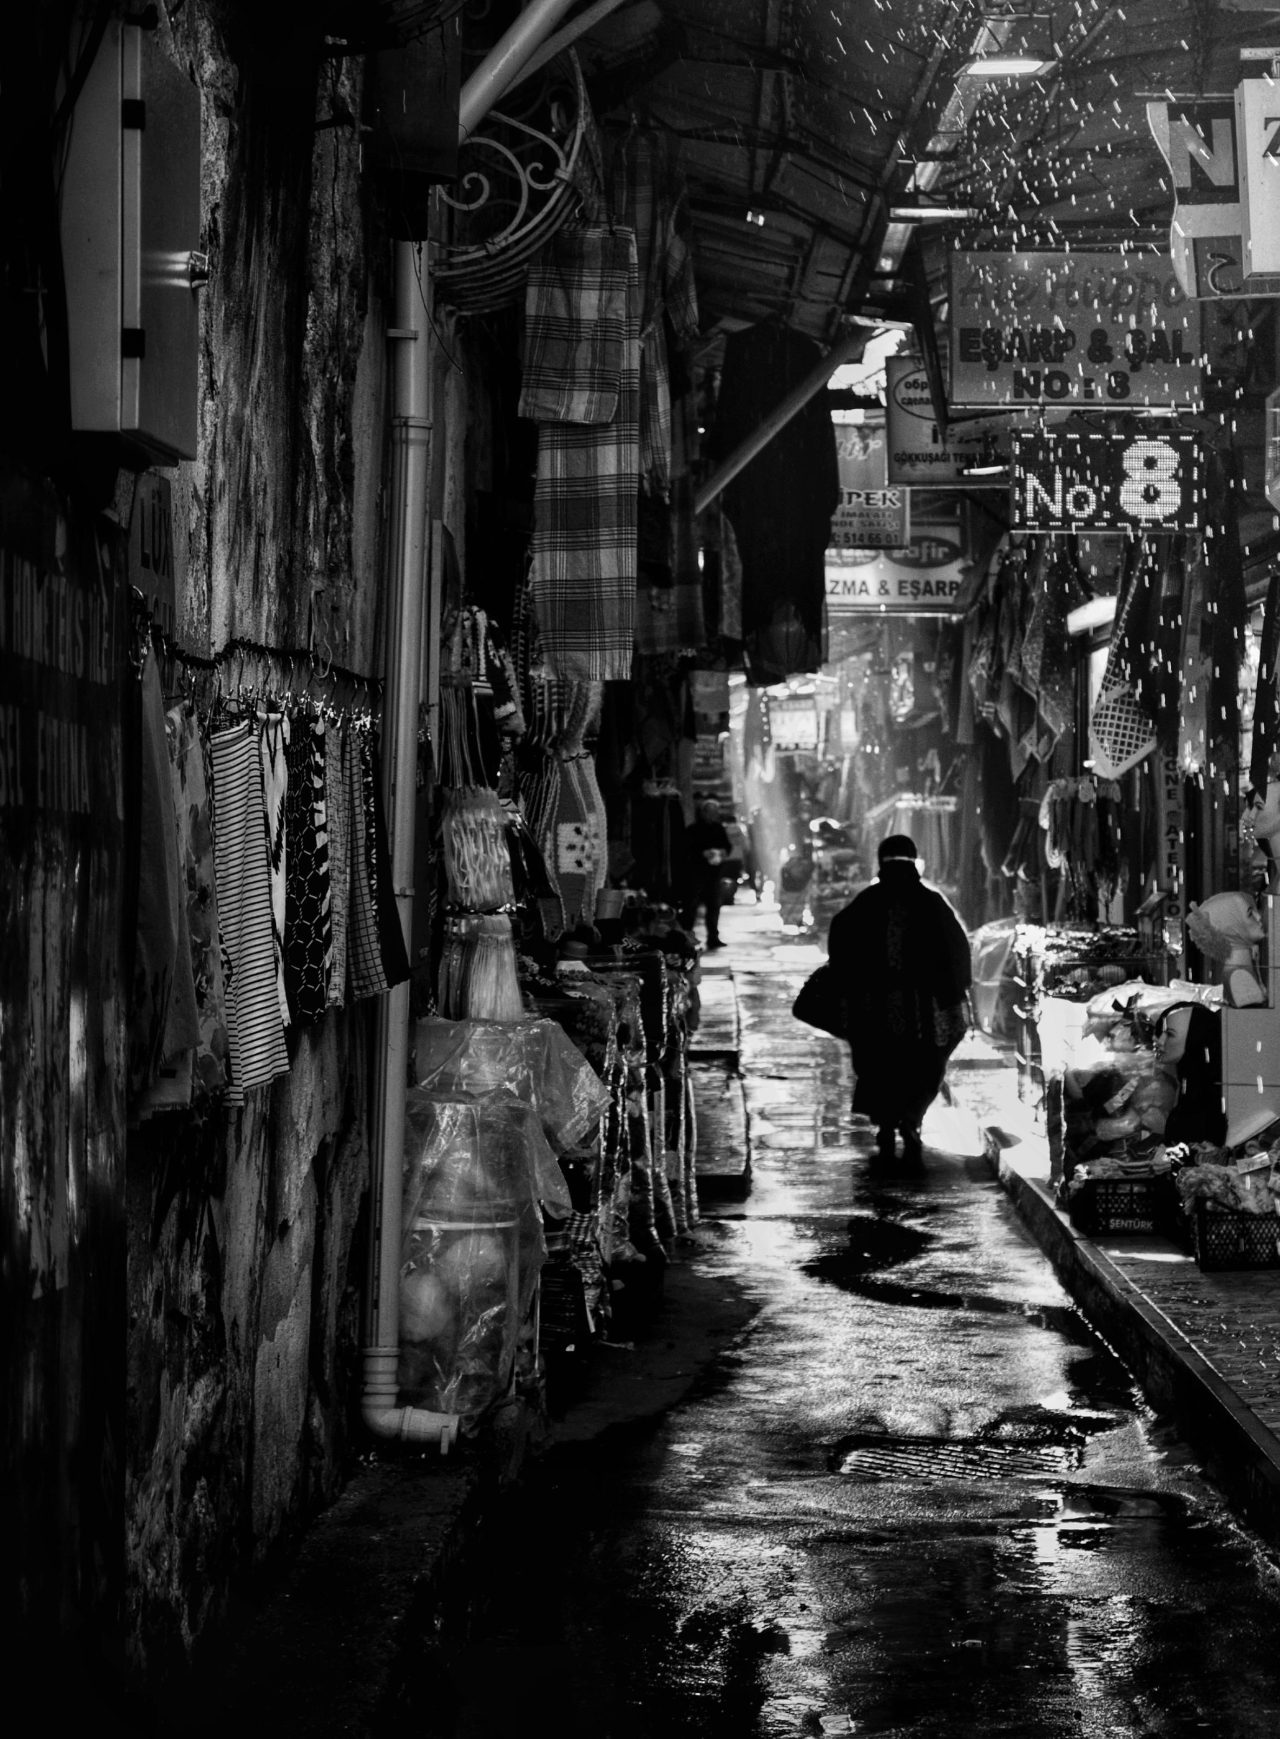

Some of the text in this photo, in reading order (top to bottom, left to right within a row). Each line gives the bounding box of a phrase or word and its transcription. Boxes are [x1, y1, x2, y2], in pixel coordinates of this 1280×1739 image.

[960, 327, 1195, 372] EŞARP & ŞAL
[1119, 440, 1182, 520] 8
[898, 579, 960, 601] EŞARP
